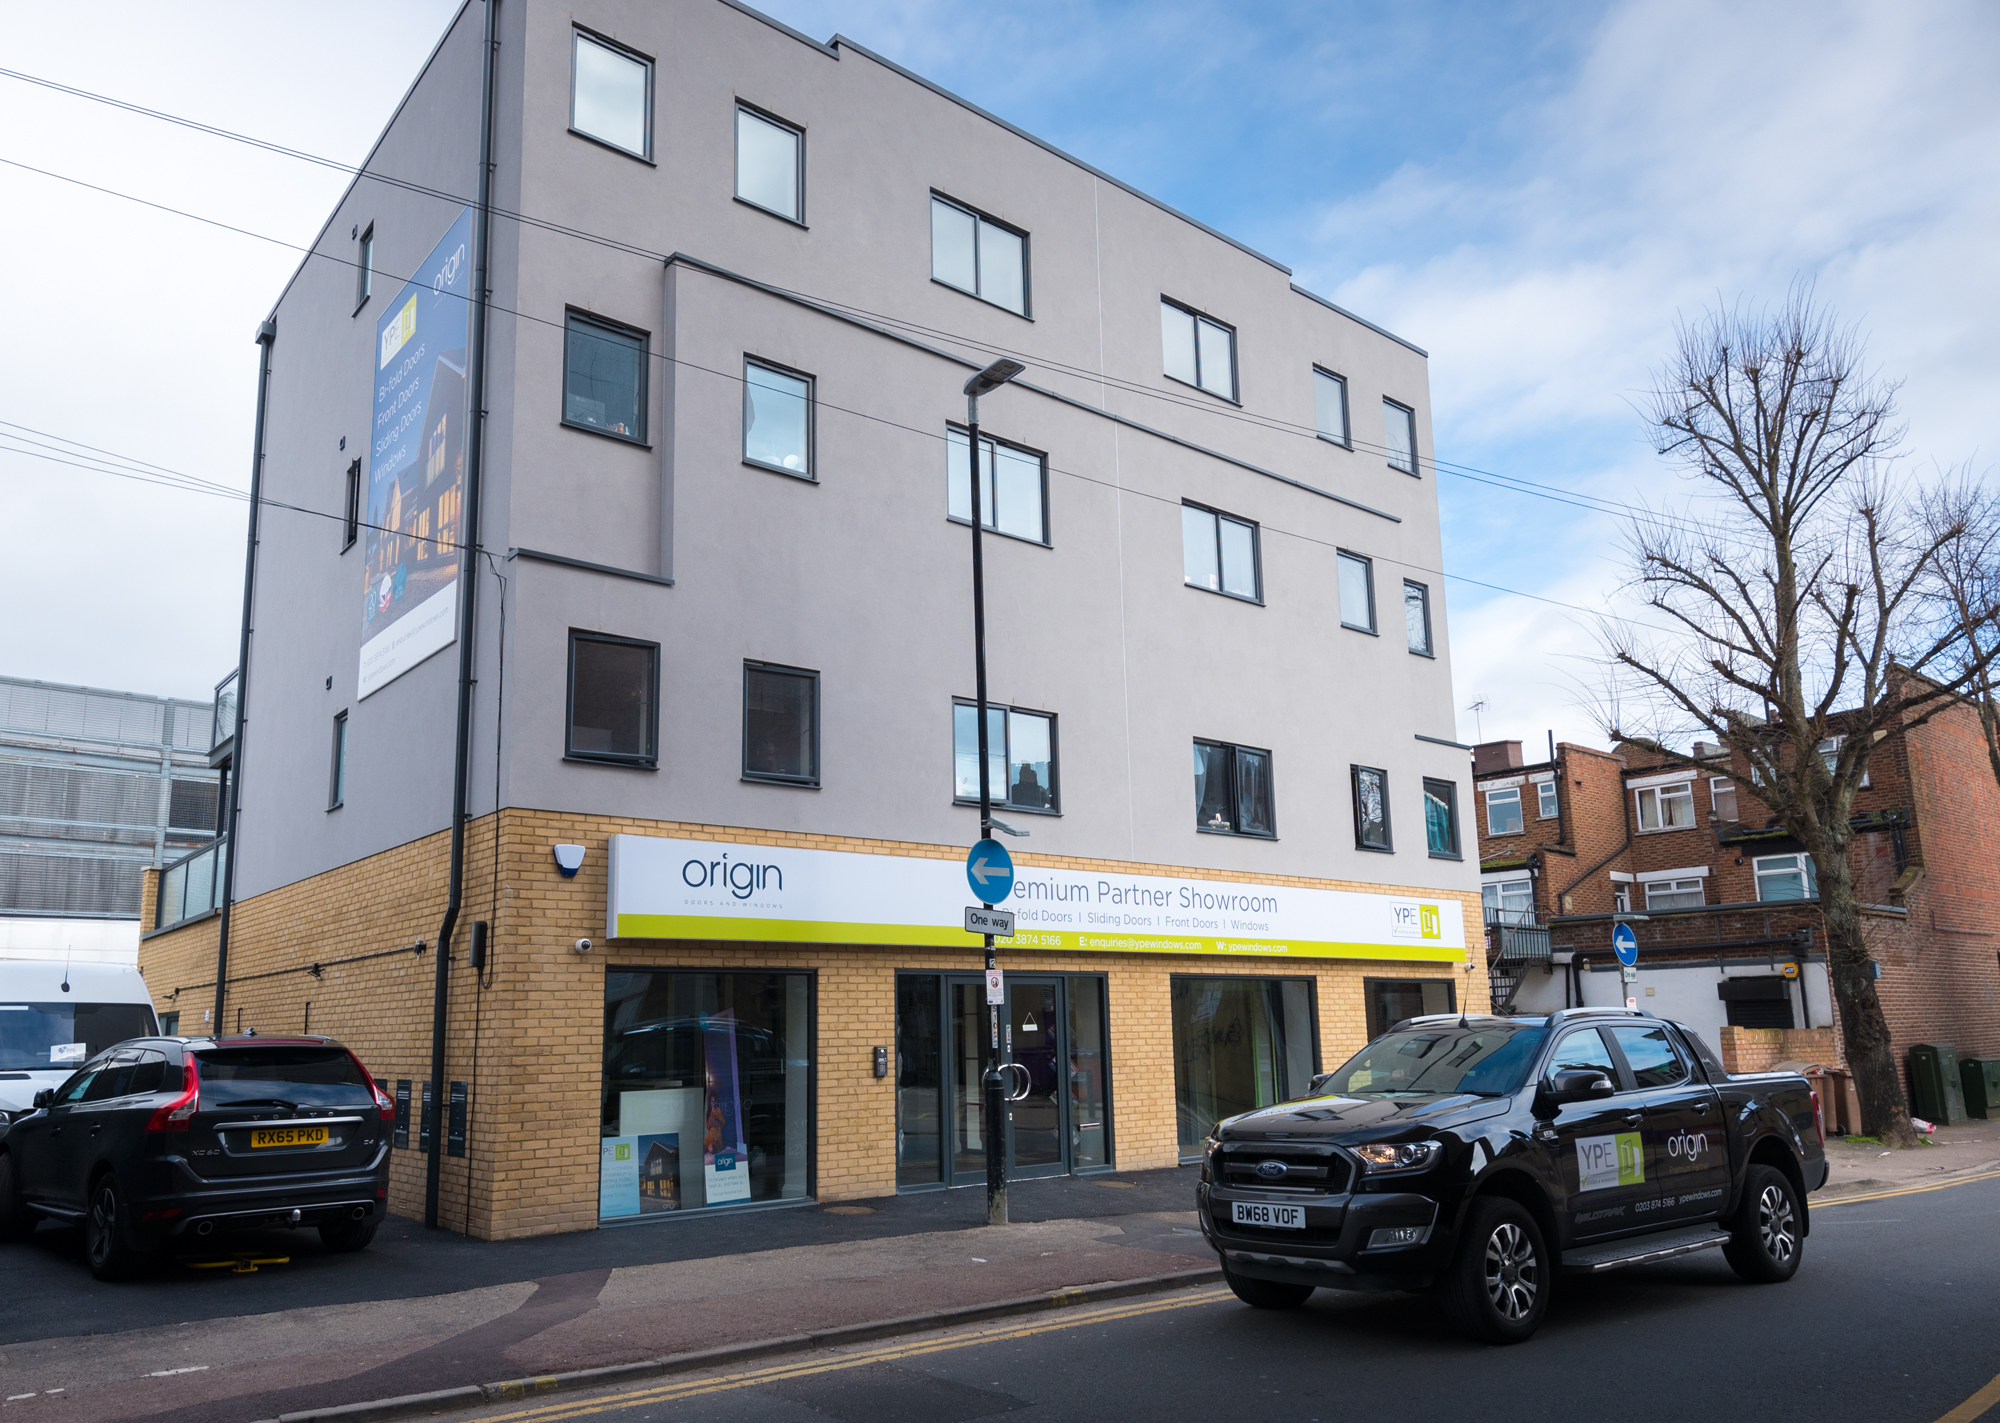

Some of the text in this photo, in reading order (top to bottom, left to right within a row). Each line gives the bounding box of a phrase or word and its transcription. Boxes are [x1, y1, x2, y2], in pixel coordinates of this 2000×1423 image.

[433, 243, 465, 296] origin
[384, 318, 401, 352] YPE
[379, 365, 403, 403] Bi-fold
[403, 343, 426, 377] Doors
[377, 377, 420, 430] Front Doors
[376, 401, 422, 457] Sliding Doors
[374, 445, 407, 484] Windows
[682, 852, 783, 900] origin
[1013, 877, 1278, 914] emium Partner Showroom
[970, 912, 1009, 931] One way
[1041, 909, 1073, 923] Doors
[1087, 911, 1121, 927] Sliding
[1123, 913, 1152, 926] Doors
[1165, 916, 1190, 928] Front
[1192, 917, 1219, 929] Doors
[1230, 919, 1269, 932] Windows
[1393, 906, 1418, 925] YPE
[994, 933, 1289, 953] 020 3874 5166 E: enquiries@ypewindows.com W: ypewindows.com
[252, 1111, 334, 1120] VOLVO
[257, 1128, 323, 1145] RX65 PKD
[1667, 1129, 1709, 1162] origin
[603, 1146, 614, 1156] PE
[717, 1157, 734, 1166] origin
[1580, 1142, 1615, 1170] YPE
[1261, 1163, 1279, 1175] Ford
[1669, 1162, 1710, 1175] Premium Partner
[1634, 1188, 1723, 1213] 0203 874 5166 ypewindows.com
[1236, 1204, 1299, 1225] BW68 VOF
